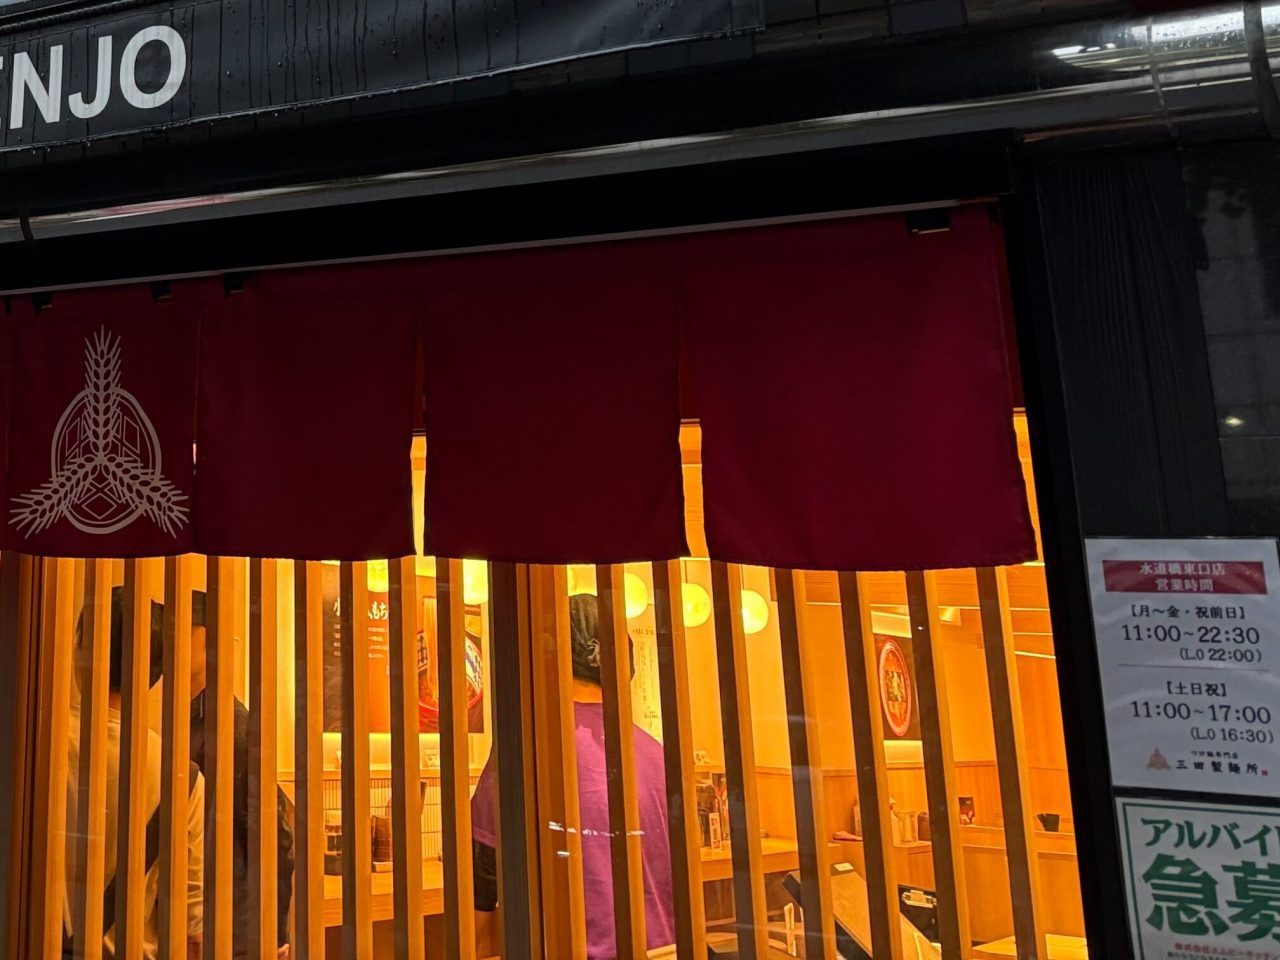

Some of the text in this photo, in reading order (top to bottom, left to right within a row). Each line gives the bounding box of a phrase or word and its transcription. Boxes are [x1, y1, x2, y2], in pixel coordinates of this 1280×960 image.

[1140, 562, 1226, 576] 水道橋東口店
[1155, 578, 1214, 592] 営業時間
[1167, 681, 1227, 697] 【土日祝】
[1175, 759, 1259, 776] 三田製麺所
